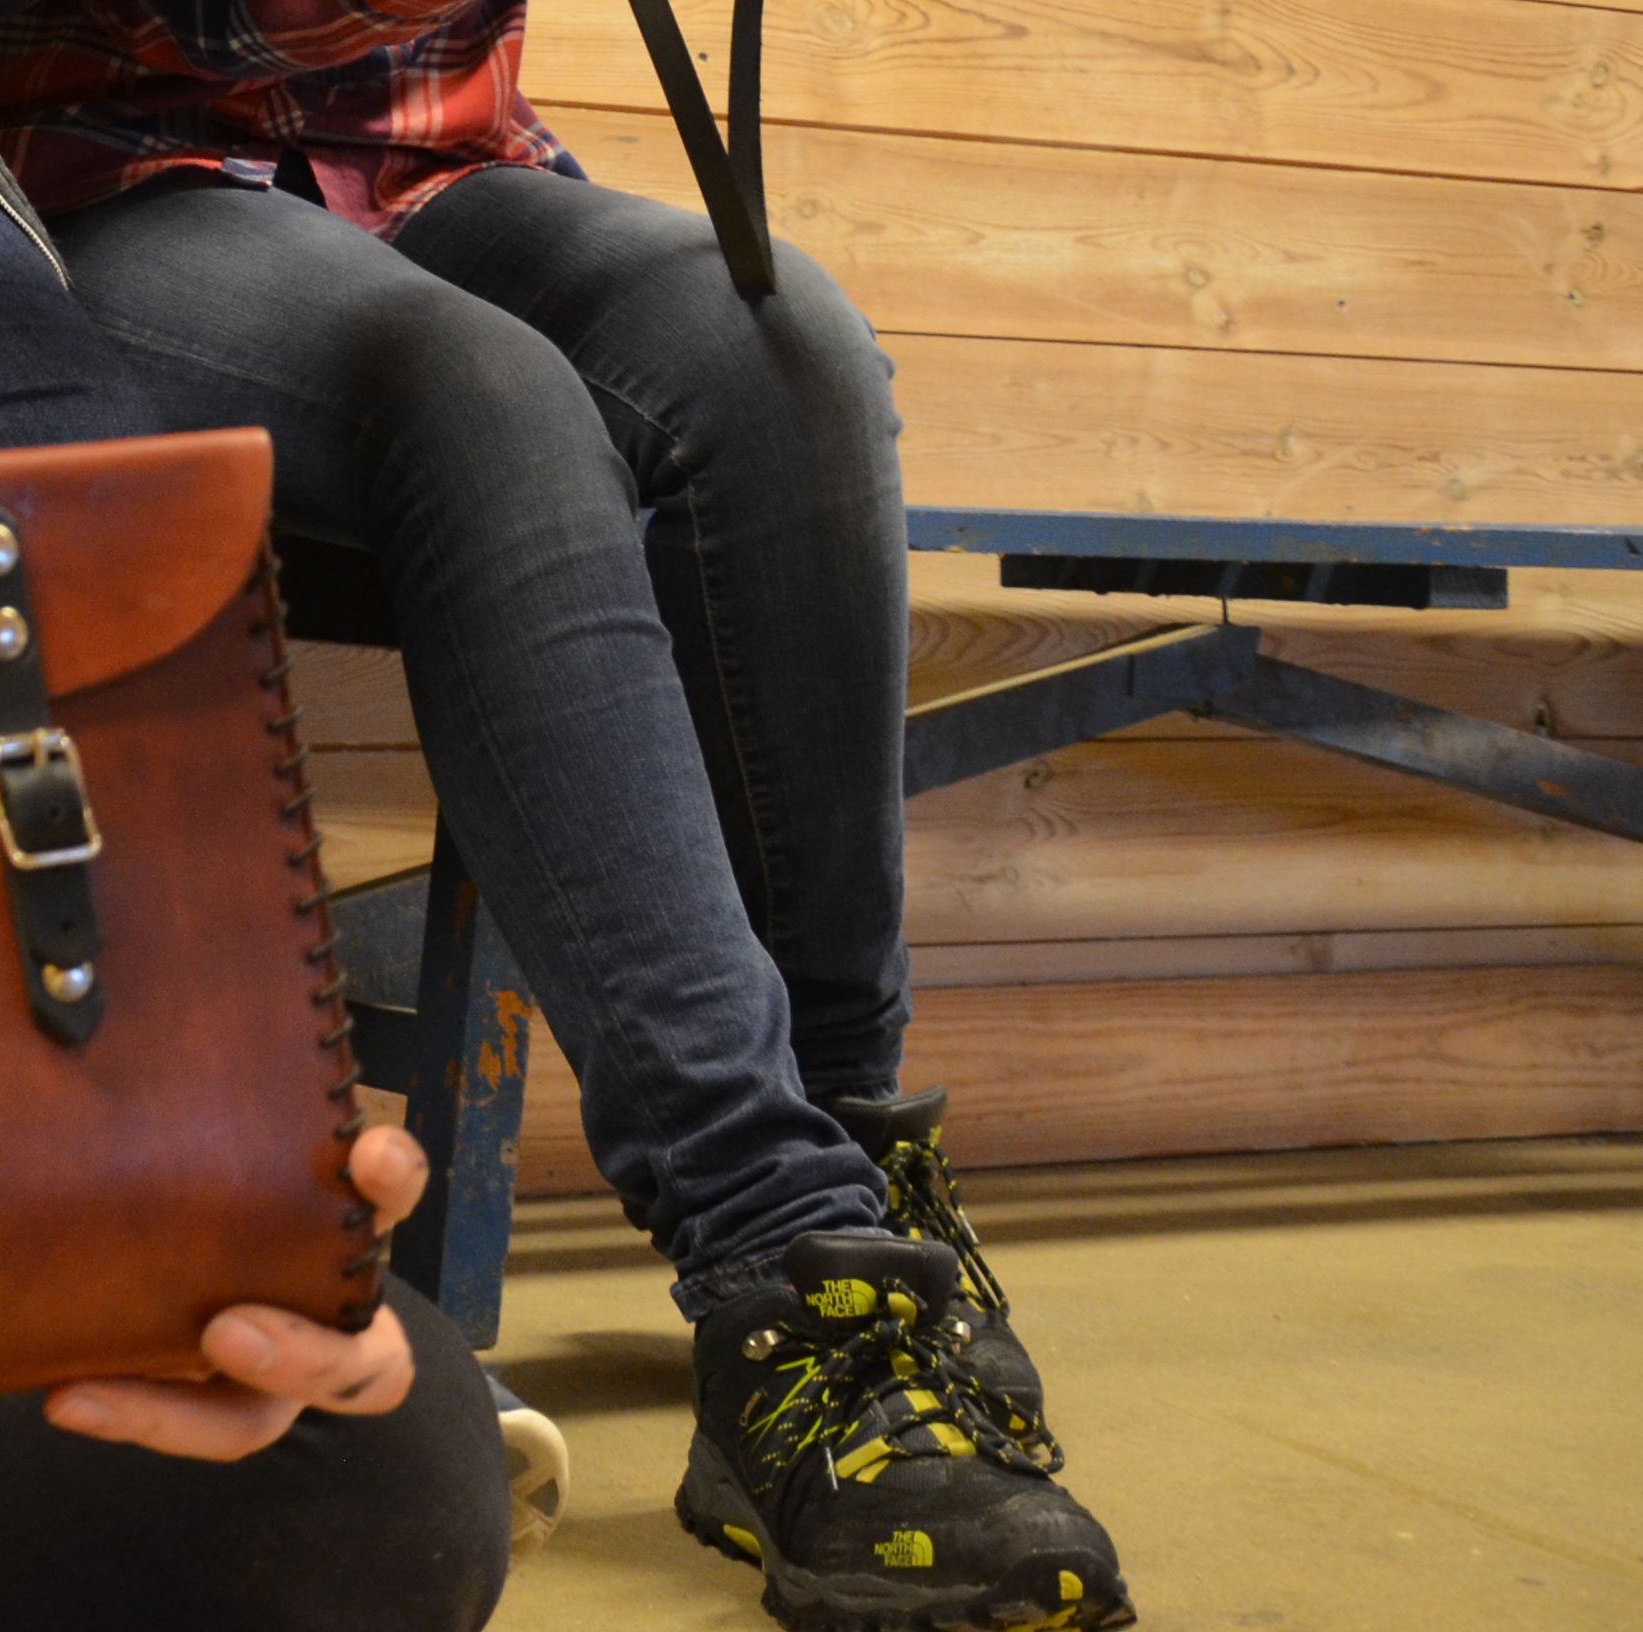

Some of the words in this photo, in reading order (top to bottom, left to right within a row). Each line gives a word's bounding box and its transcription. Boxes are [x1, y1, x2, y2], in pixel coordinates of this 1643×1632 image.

[822, 1279, 852, 1294] THE
[805, 1289, 853, 1306] NORTH
[819, 1304, 855, 1318] FACE
[893, 1530, 914, 1543] THE
[875, 1542, 914, 1555] NORTH
[884, 1553, 912, 1567] FACE
